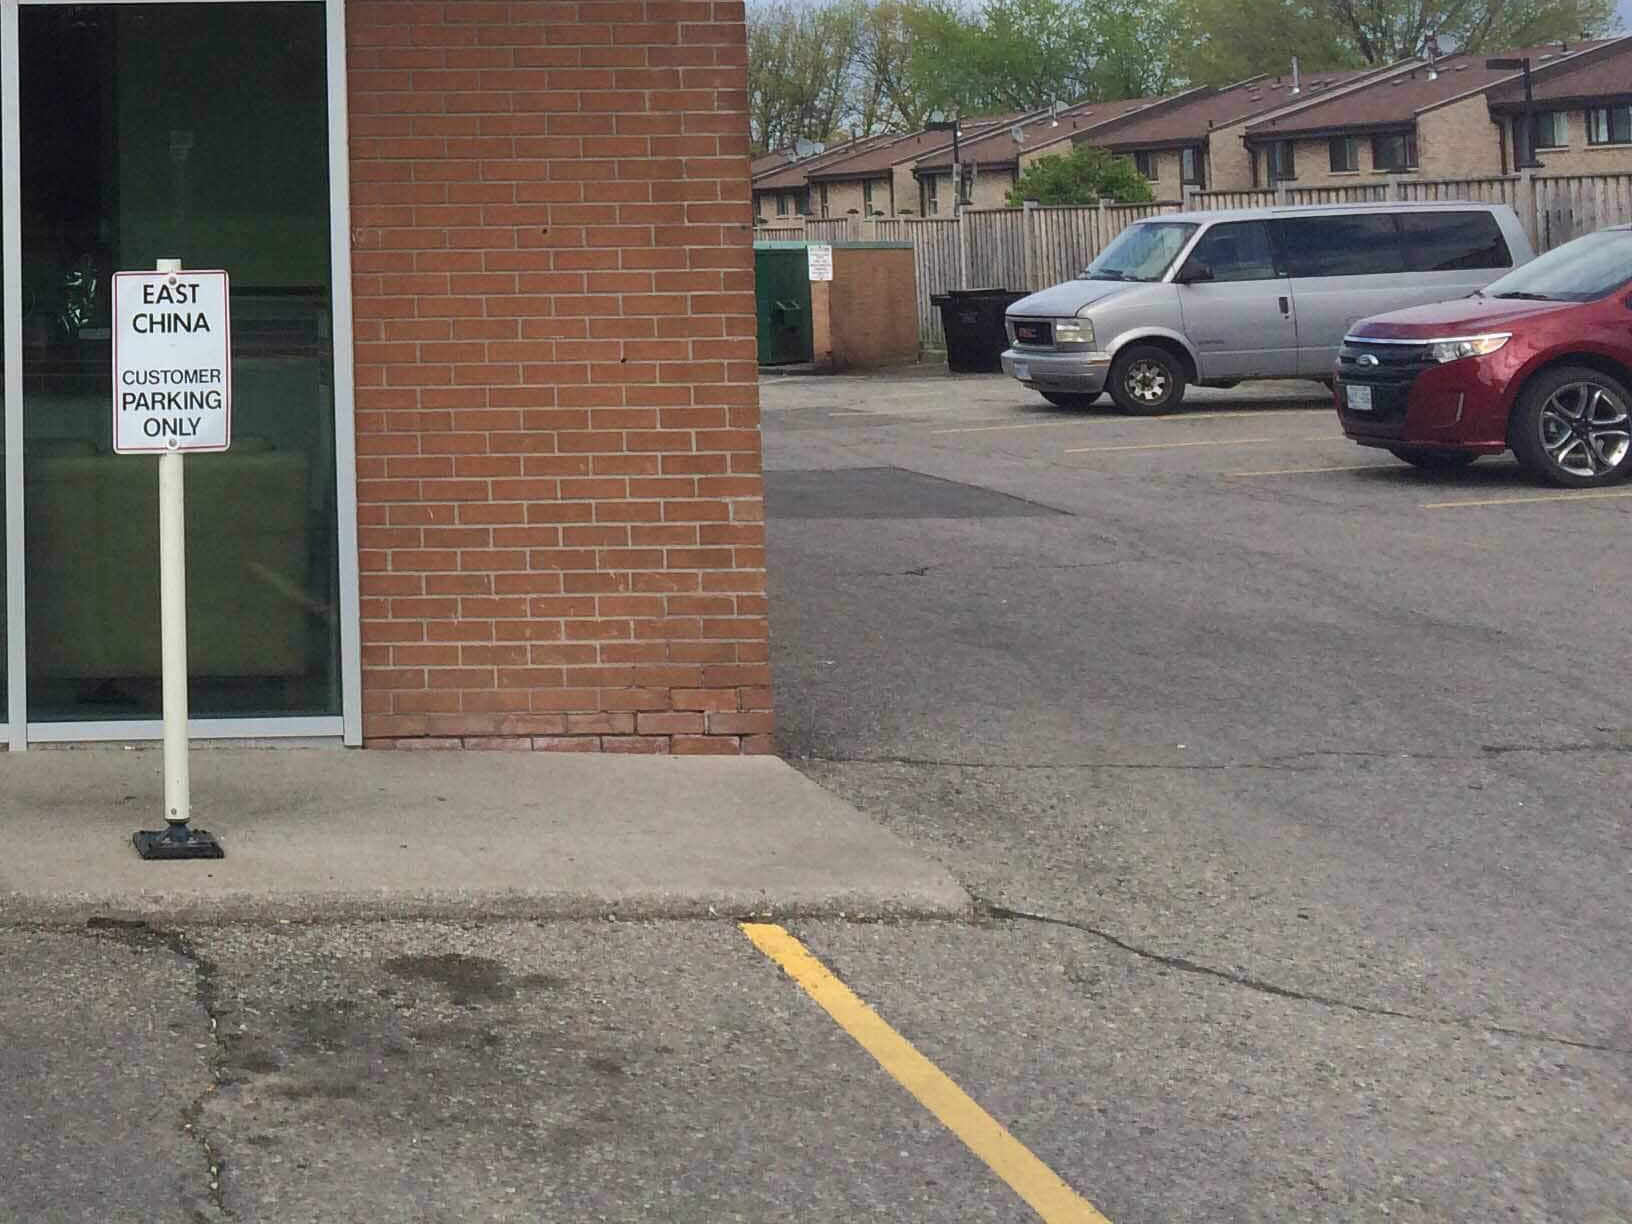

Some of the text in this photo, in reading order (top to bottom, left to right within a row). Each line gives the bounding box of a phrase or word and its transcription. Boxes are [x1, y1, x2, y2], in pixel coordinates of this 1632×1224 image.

[143, 284, 200, 304] EAST
[132, 312, 211, 333] CHINA
[122, 369, 222, 385] CUSTOMER
[122, 390, 222, 411] PARKING
[143, 417, 201, 437] ONLY
